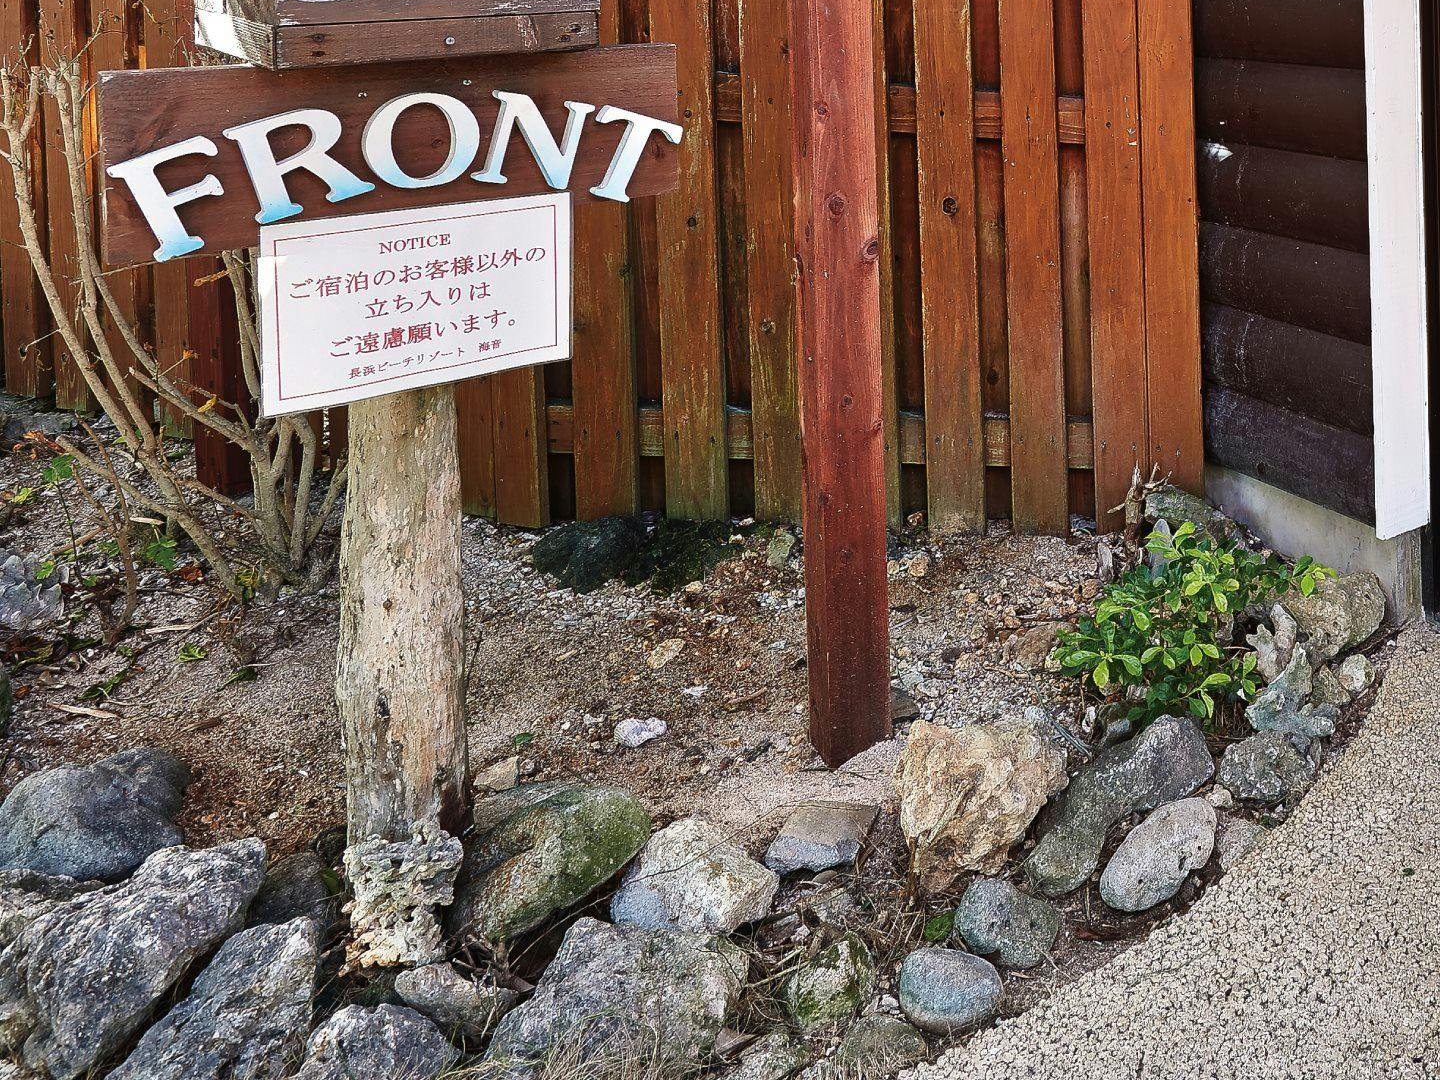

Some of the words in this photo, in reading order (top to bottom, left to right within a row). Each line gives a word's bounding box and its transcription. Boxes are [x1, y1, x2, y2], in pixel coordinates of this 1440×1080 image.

[106, 90, 683, 264] FRONT
[378, 232, 452, 255] NOTICE
[289, 246, 546, 300] ご宿泊のお客様以外の
[365, 282, 491, 319] 立ち入りは
[329, 309, 517, 358] ご遠慮願います。
[348, 346, 466, 380] 長浜ビーチリゾート
